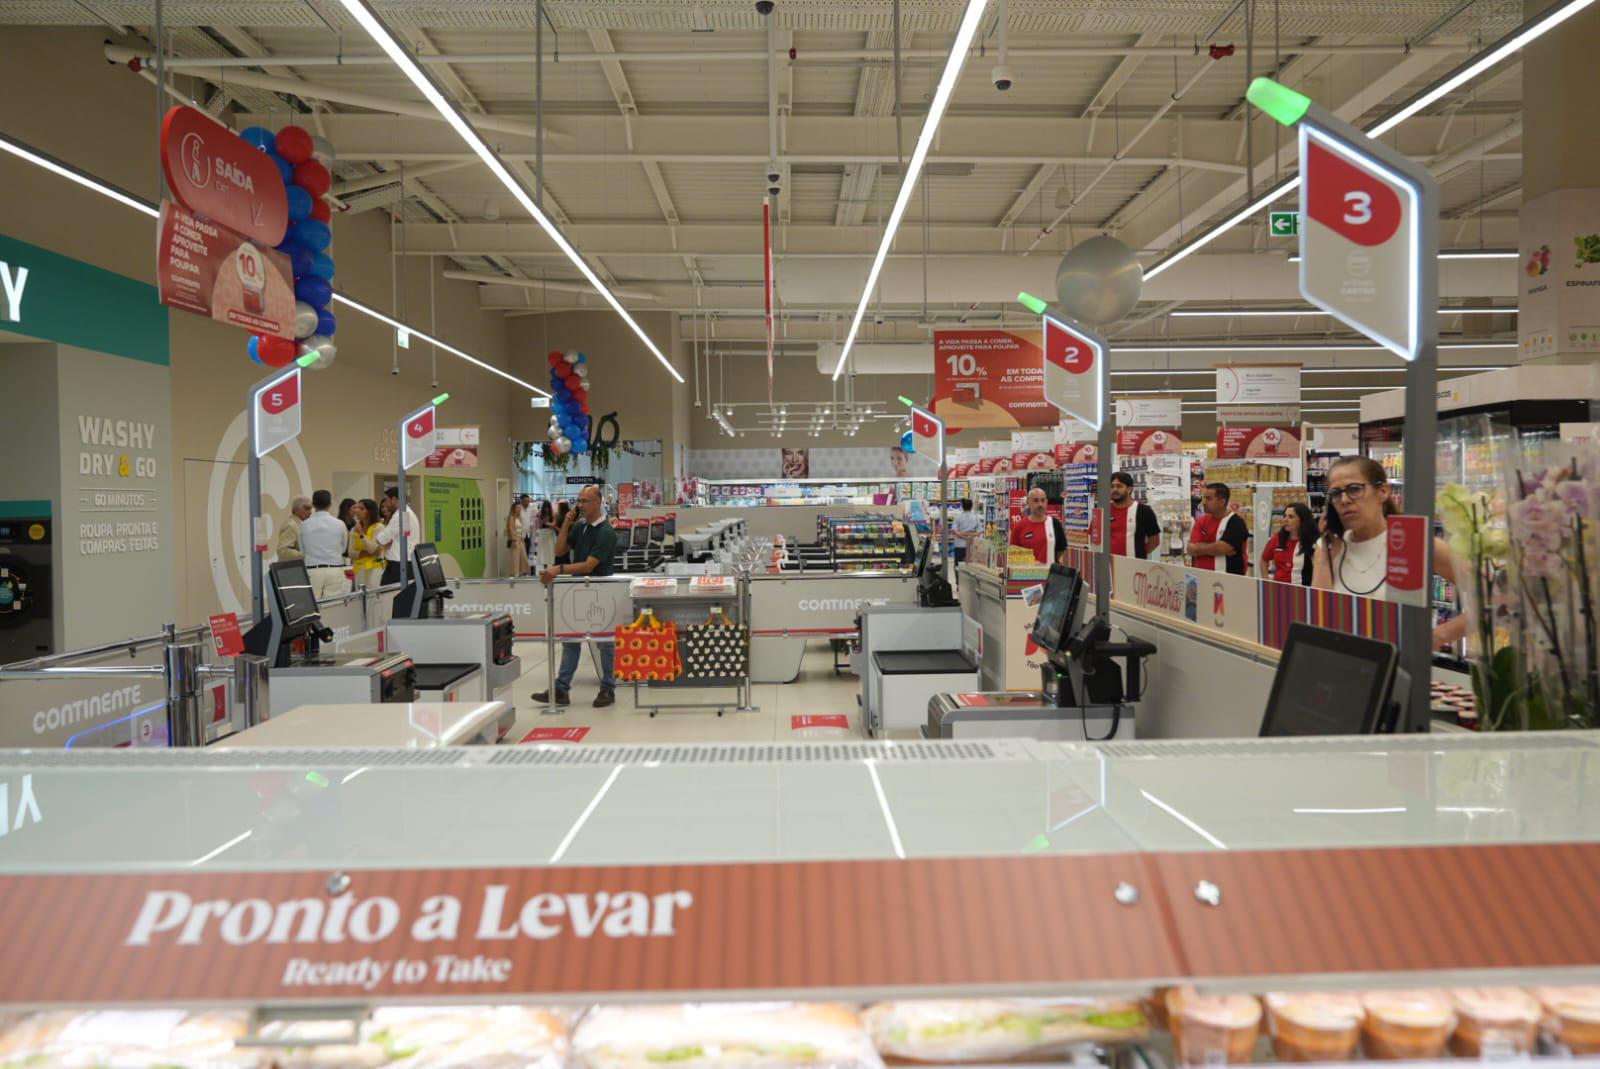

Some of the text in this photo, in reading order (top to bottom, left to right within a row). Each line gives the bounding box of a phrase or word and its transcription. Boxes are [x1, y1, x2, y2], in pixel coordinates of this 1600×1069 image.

[215, 157, 254, 194] SAÍDA
[1343, 190, 1373, 225] 3
[0, 260, 29, 322] Y
[946, 354, 988, 376] 10%
[1064, 347, 1080, 364] 2
[271, 393, 283, 406] 5
[79, 416, 155, 449] WASHY
[414, 423, 424, 432] 4
[923, 422, 930, 433] 1
[79, 453, 156, 478] DRY & GO
[108, 494, 145, 507] MINUTOS
[80, 522, 159, 538] ROUPA PRONTA E
[80, 537, 159, 555] COMPRAS FEITAS
[1133, 571, 1182, 613] Madeira
[32, 684, 142, 734] CONTINENTE
[124, 884, 694, 948] Pronto a Levar
[281, 955, 513, 990] Ready to Take
